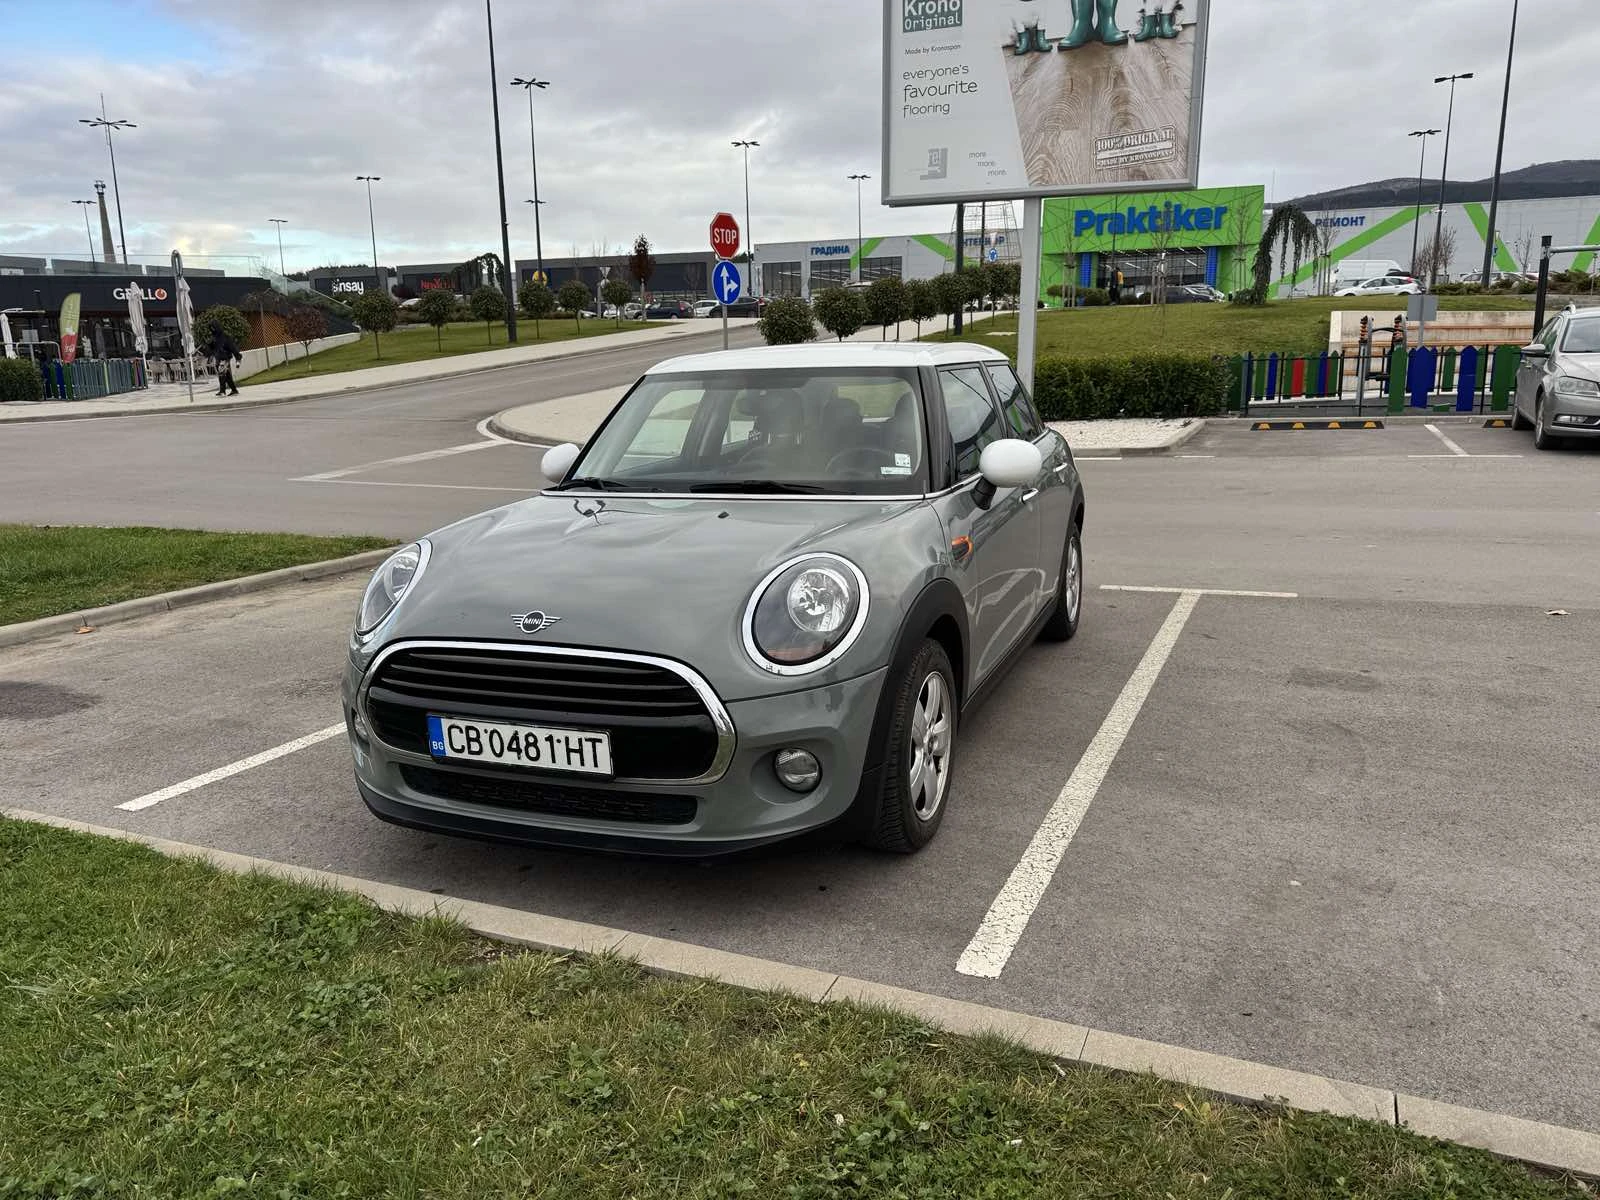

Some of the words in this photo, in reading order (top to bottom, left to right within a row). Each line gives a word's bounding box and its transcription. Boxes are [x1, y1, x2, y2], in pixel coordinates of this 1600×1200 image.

[903, 0, 961, 17] Krono
[904, 12, 961, 31] Original
[902, 64, 969, 81] everyone's
[903, 80, 978, 103] favourite
[902, 103, 950, 119] flooring
[1074, 201, 1228, 237] Praktiker
[1314, 215, 1366, 228] РЕМОНТ
[713, 227, 737, 245] STOP
[810, 244, 850, 256] ГРАДИНА
[113, 288, 167, 301] GRLLO
[524, 617, 541, 625] MINI
[432, 740, 444, 751] BG
